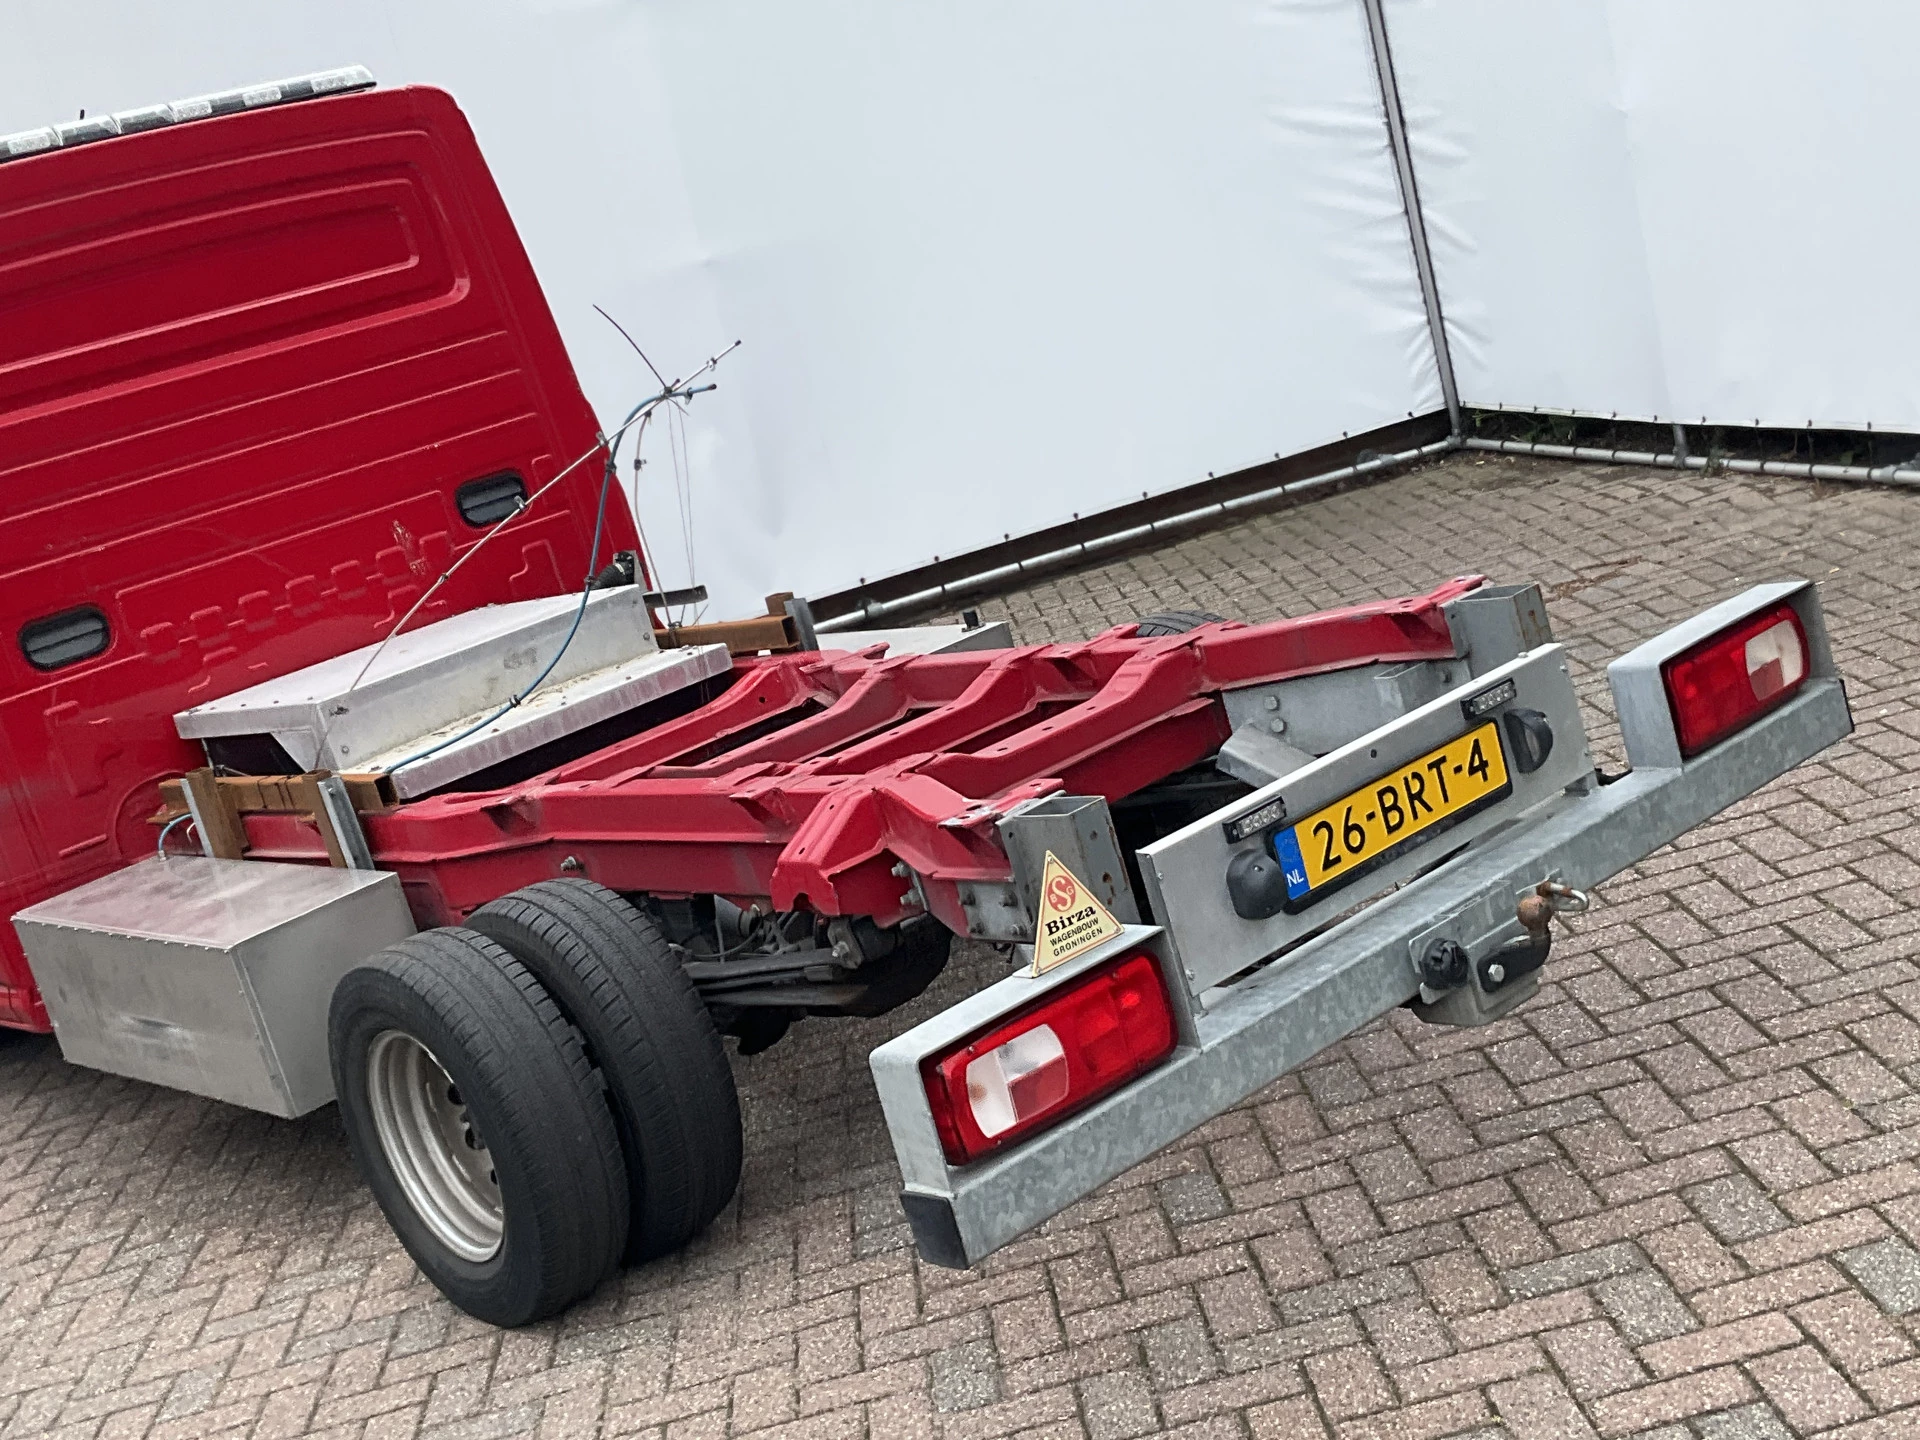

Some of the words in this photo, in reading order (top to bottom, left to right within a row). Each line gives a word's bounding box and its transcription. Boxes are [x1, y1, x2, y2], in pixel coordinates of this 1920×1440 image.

[1312, 738, 1489, 872] 26-BRT-4
[1286, 868, 1304, 887] NL
[1045, 906, 1096, 936] Birza
[1050, 917, 1099, 946] WAGENBOUW
[1053, 926, 1103, 956] GRONINGEN
